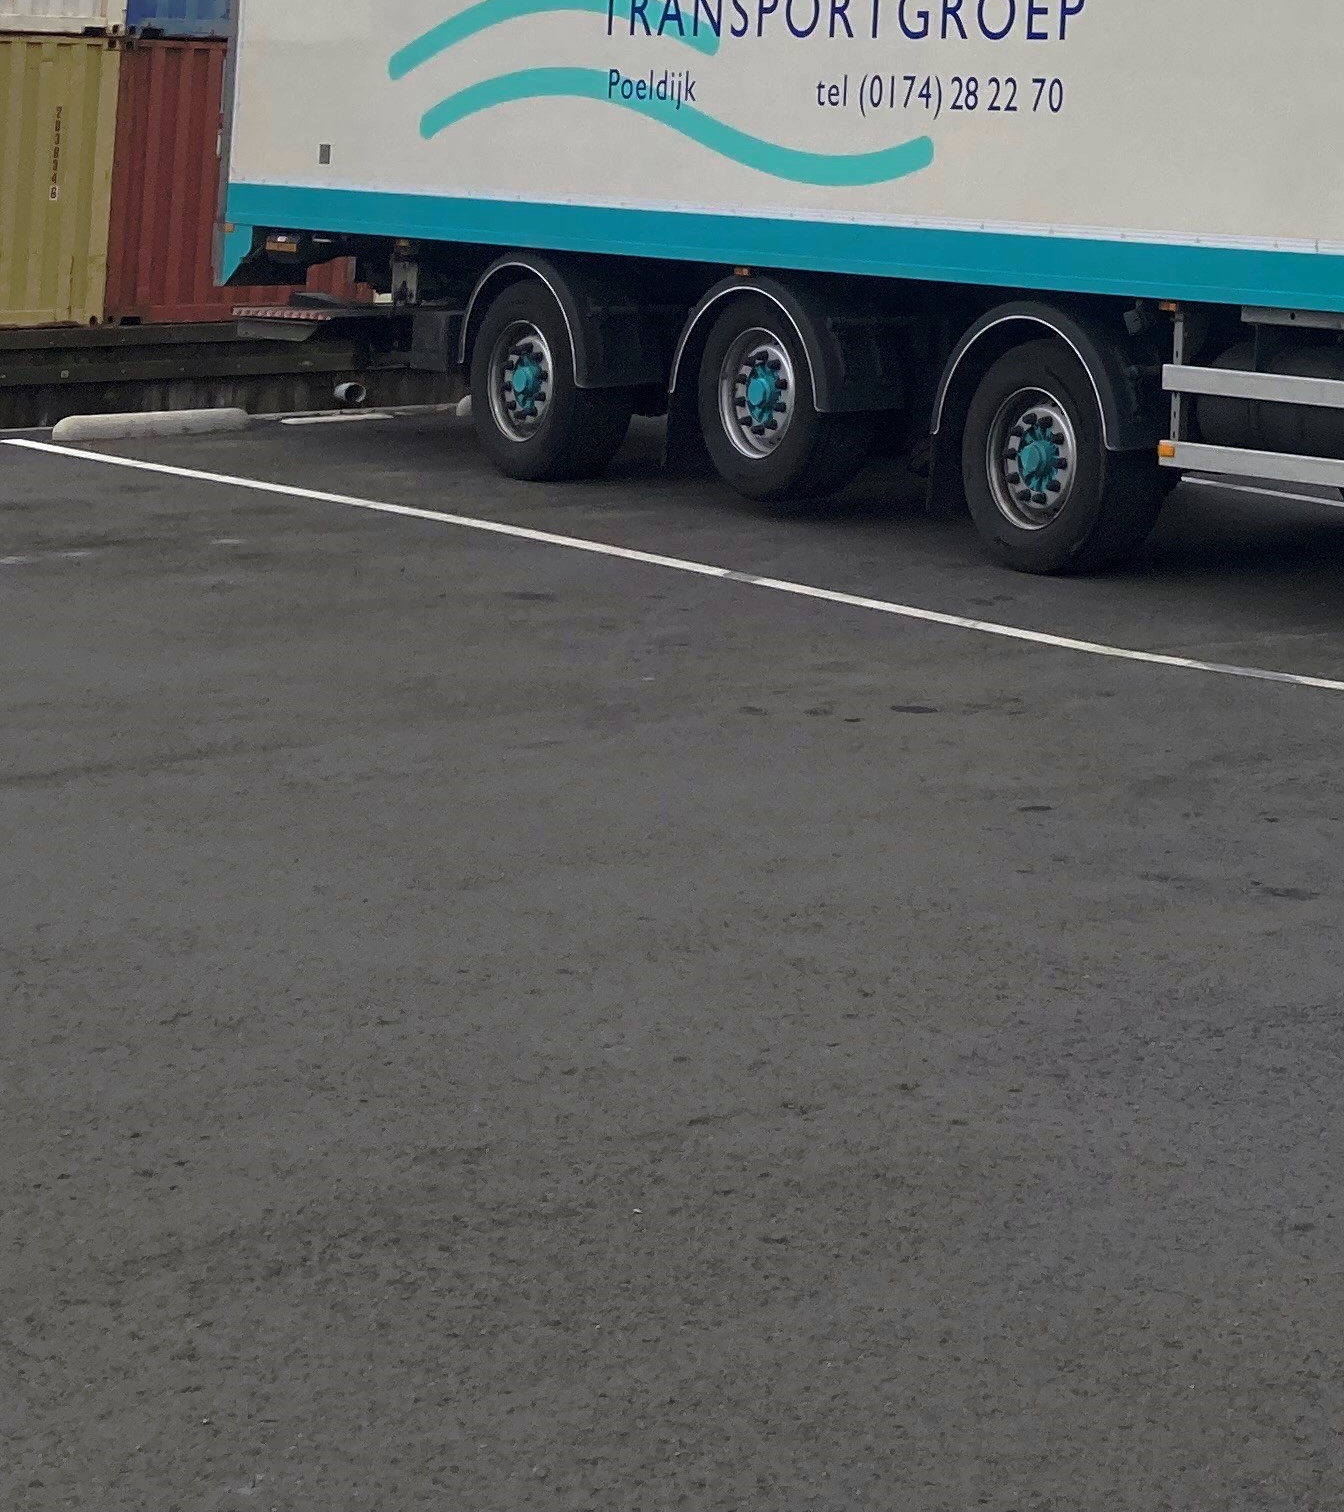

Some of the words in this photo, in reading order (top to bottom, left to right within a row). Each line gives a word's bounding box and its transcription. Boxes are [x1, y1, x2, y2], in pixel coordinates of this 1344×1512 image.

[607, 69, 697, 111] Poeldijk
[816, 74, 848, 107] tel
[859, 74, 943, 121] (0174)
[949, 76, 980, 111] 28
[986, 76, 1019, 112] 22
[1031, 76, 1064, 113] 70
